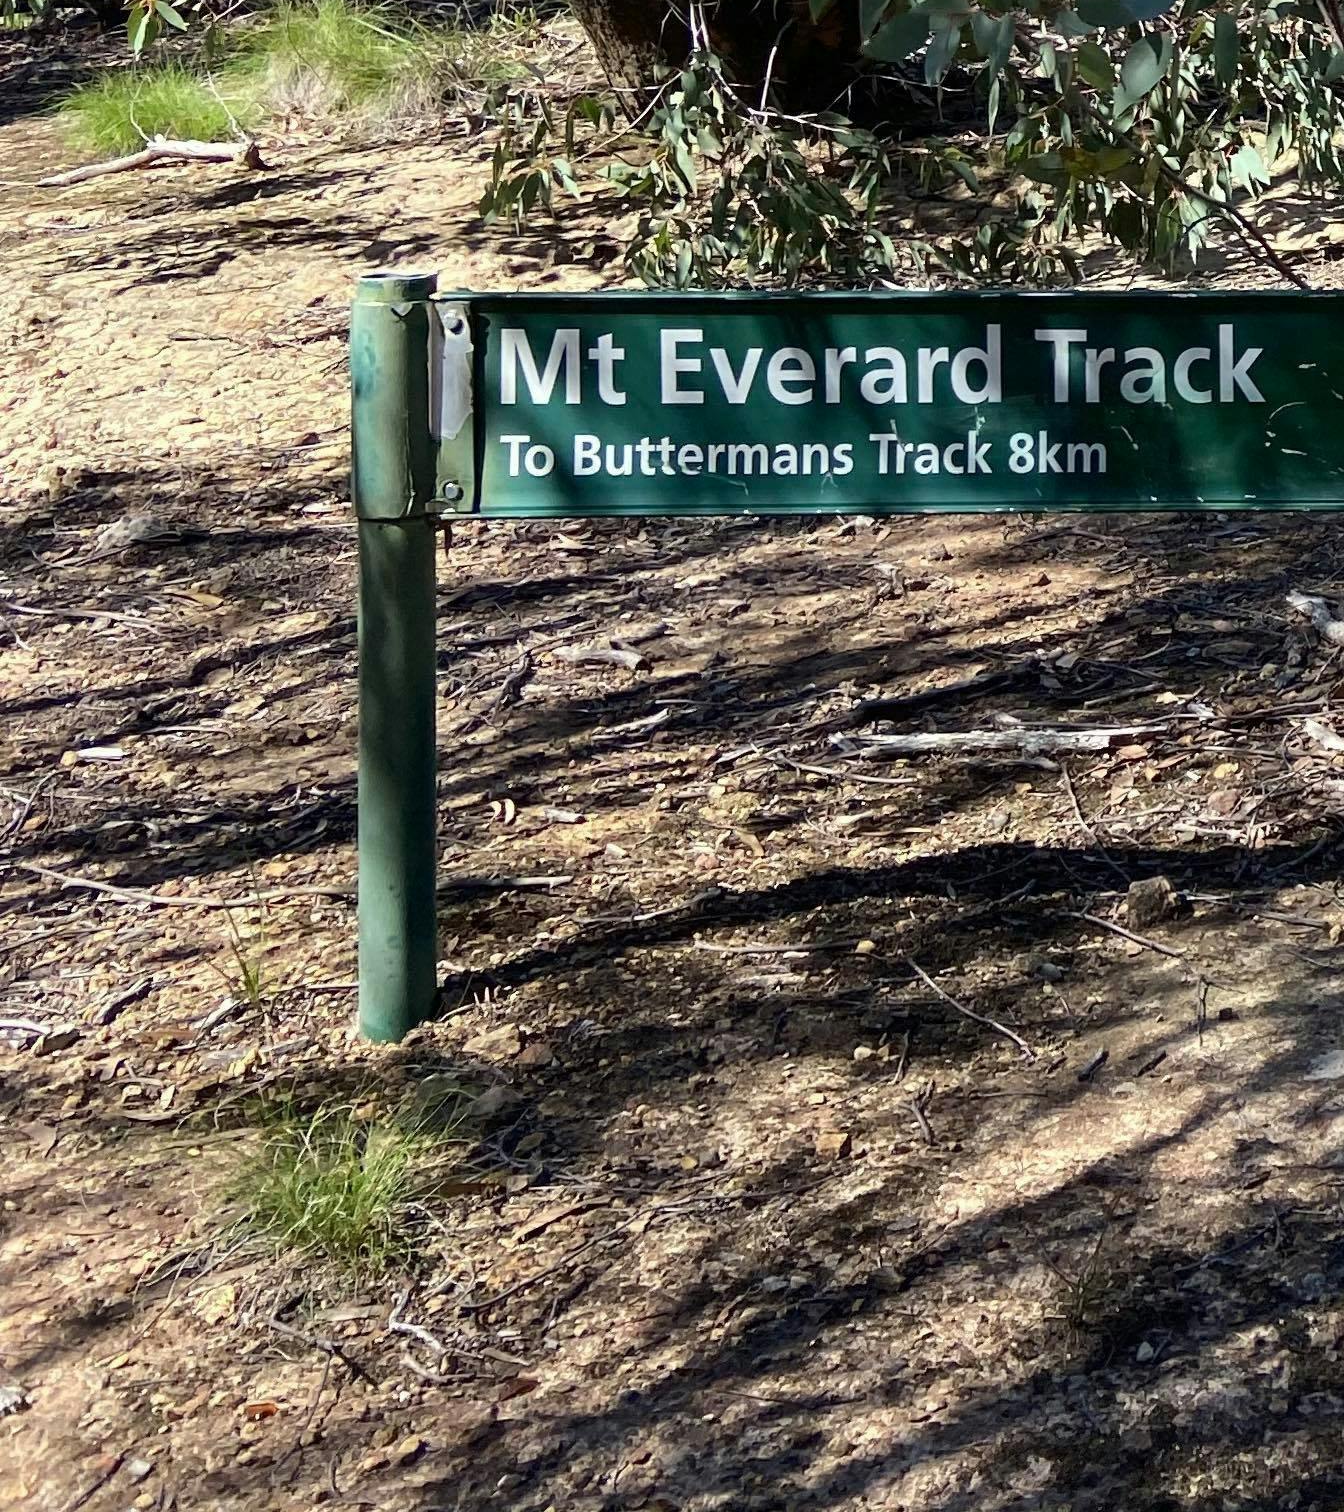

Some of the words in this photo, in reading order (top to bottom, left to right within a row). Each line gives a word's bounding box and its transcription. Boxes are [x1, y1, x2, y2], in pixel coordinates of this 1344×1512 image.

[500, 328, 627, 405] Mt
[660, 323, 1001, 405] Everard
[1035, 323, 1266, 404] Track
[500, 434, 555, 478] To
[574, 433, 854, 477] Buttermans
[869, 429, 993, 475] Track
[1008, 430, 1107, 474] 8km
